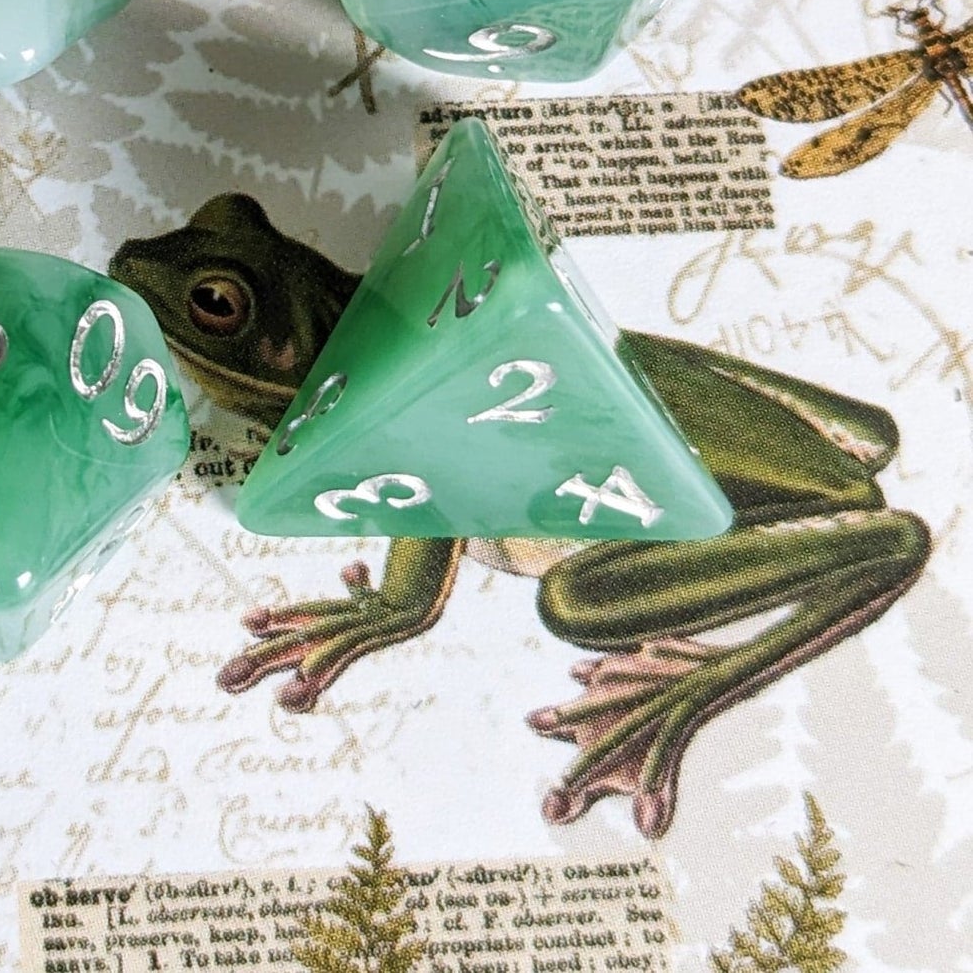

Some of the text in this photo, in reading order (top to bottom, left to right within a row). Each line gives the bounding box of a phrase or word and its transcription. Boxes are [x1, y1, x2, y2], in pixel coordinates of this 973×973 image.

[467, 360, 558, 424] 2
[314, 473, 432, 521] 3
[555, 465, 665, 527] 4
